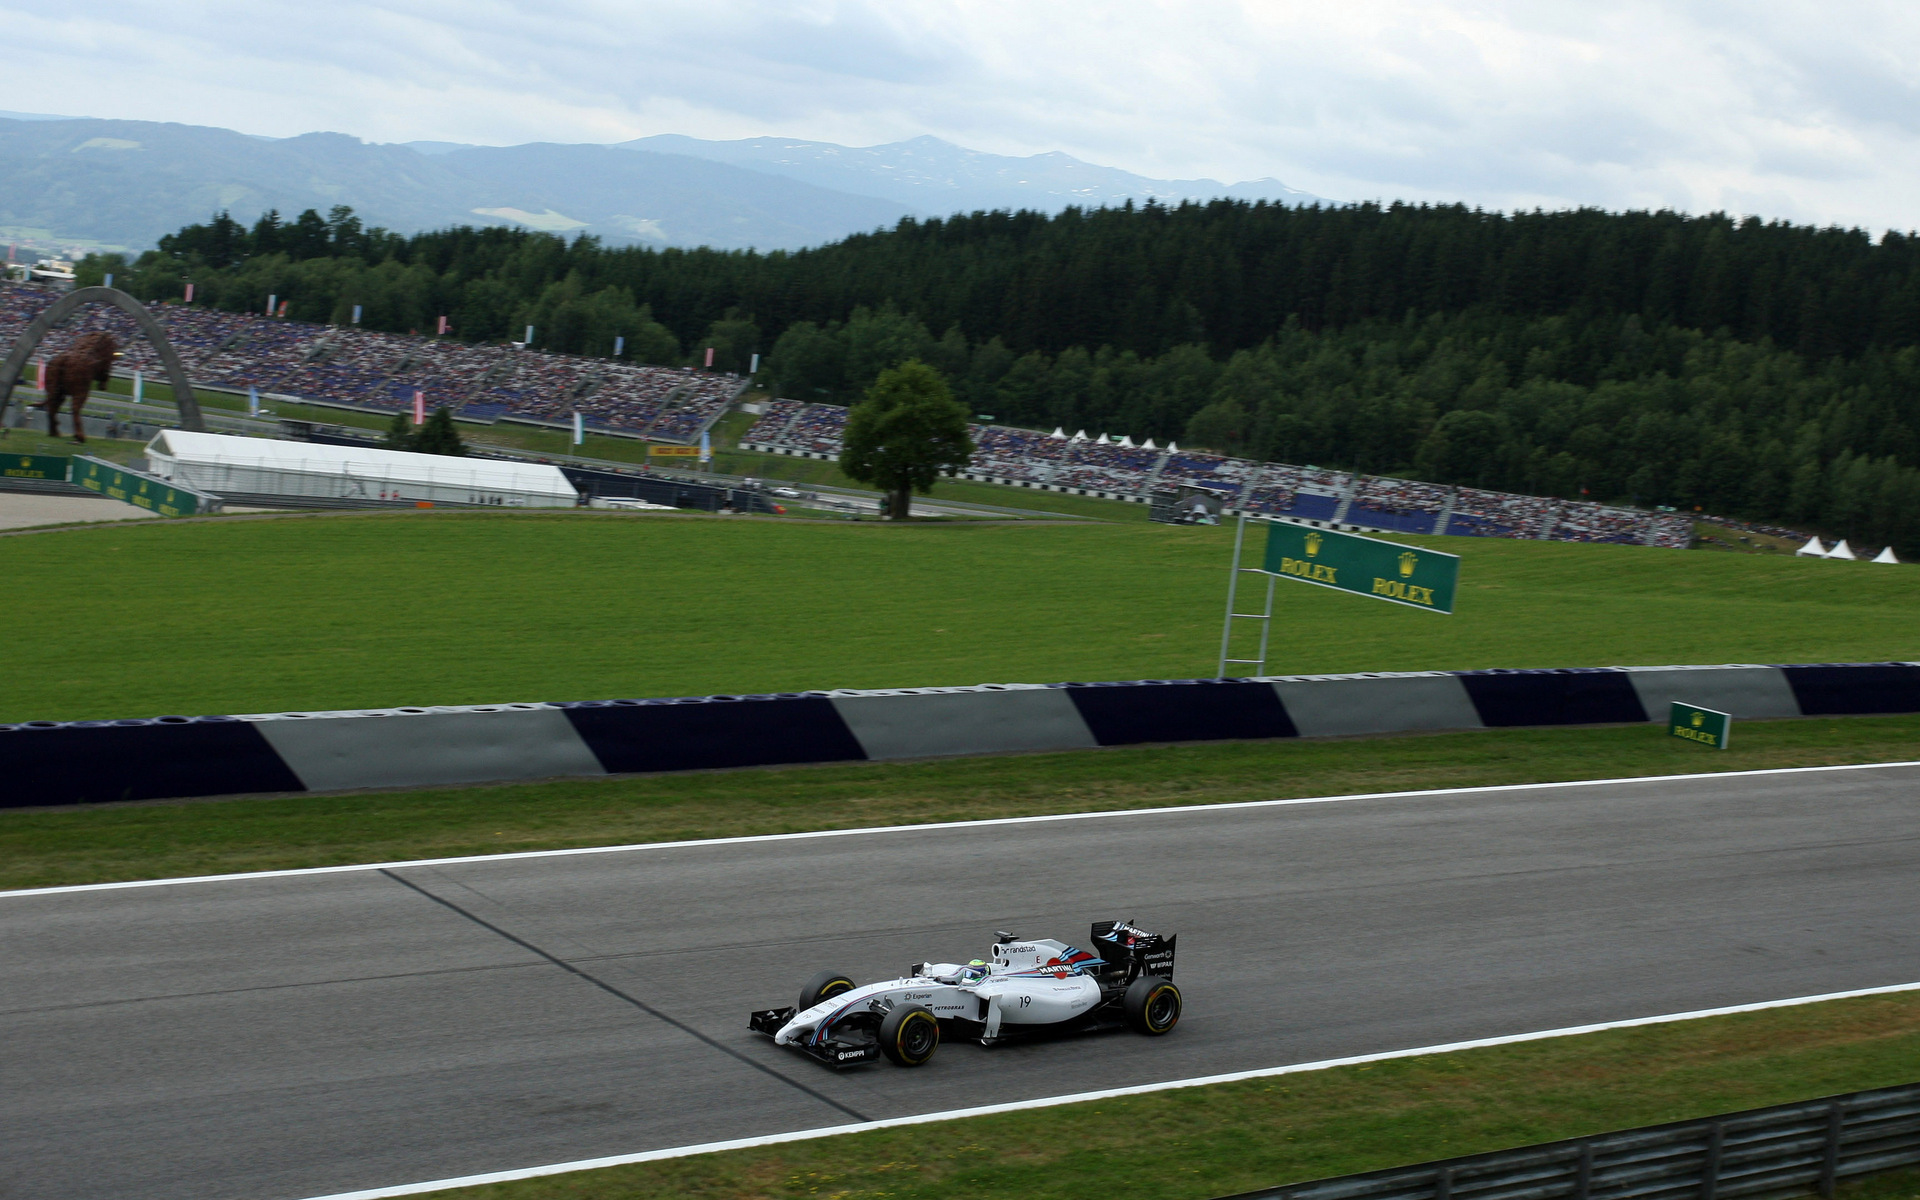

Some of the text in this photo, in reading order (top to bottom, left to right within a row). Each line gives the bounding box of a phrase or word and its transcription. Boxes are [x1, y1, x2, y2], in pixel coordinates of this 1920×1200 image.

[1281, 557, 1337, 583] ROLEX
[1373, 578, 1433, 604] ROLEX
[1674, 726, 1716, 744] ROLEX
[1010, 945, 1036, 953] randstad
[1019, 995, 1032, 1008] 19
[845, 1050, 865, 1059] KEMPPI
